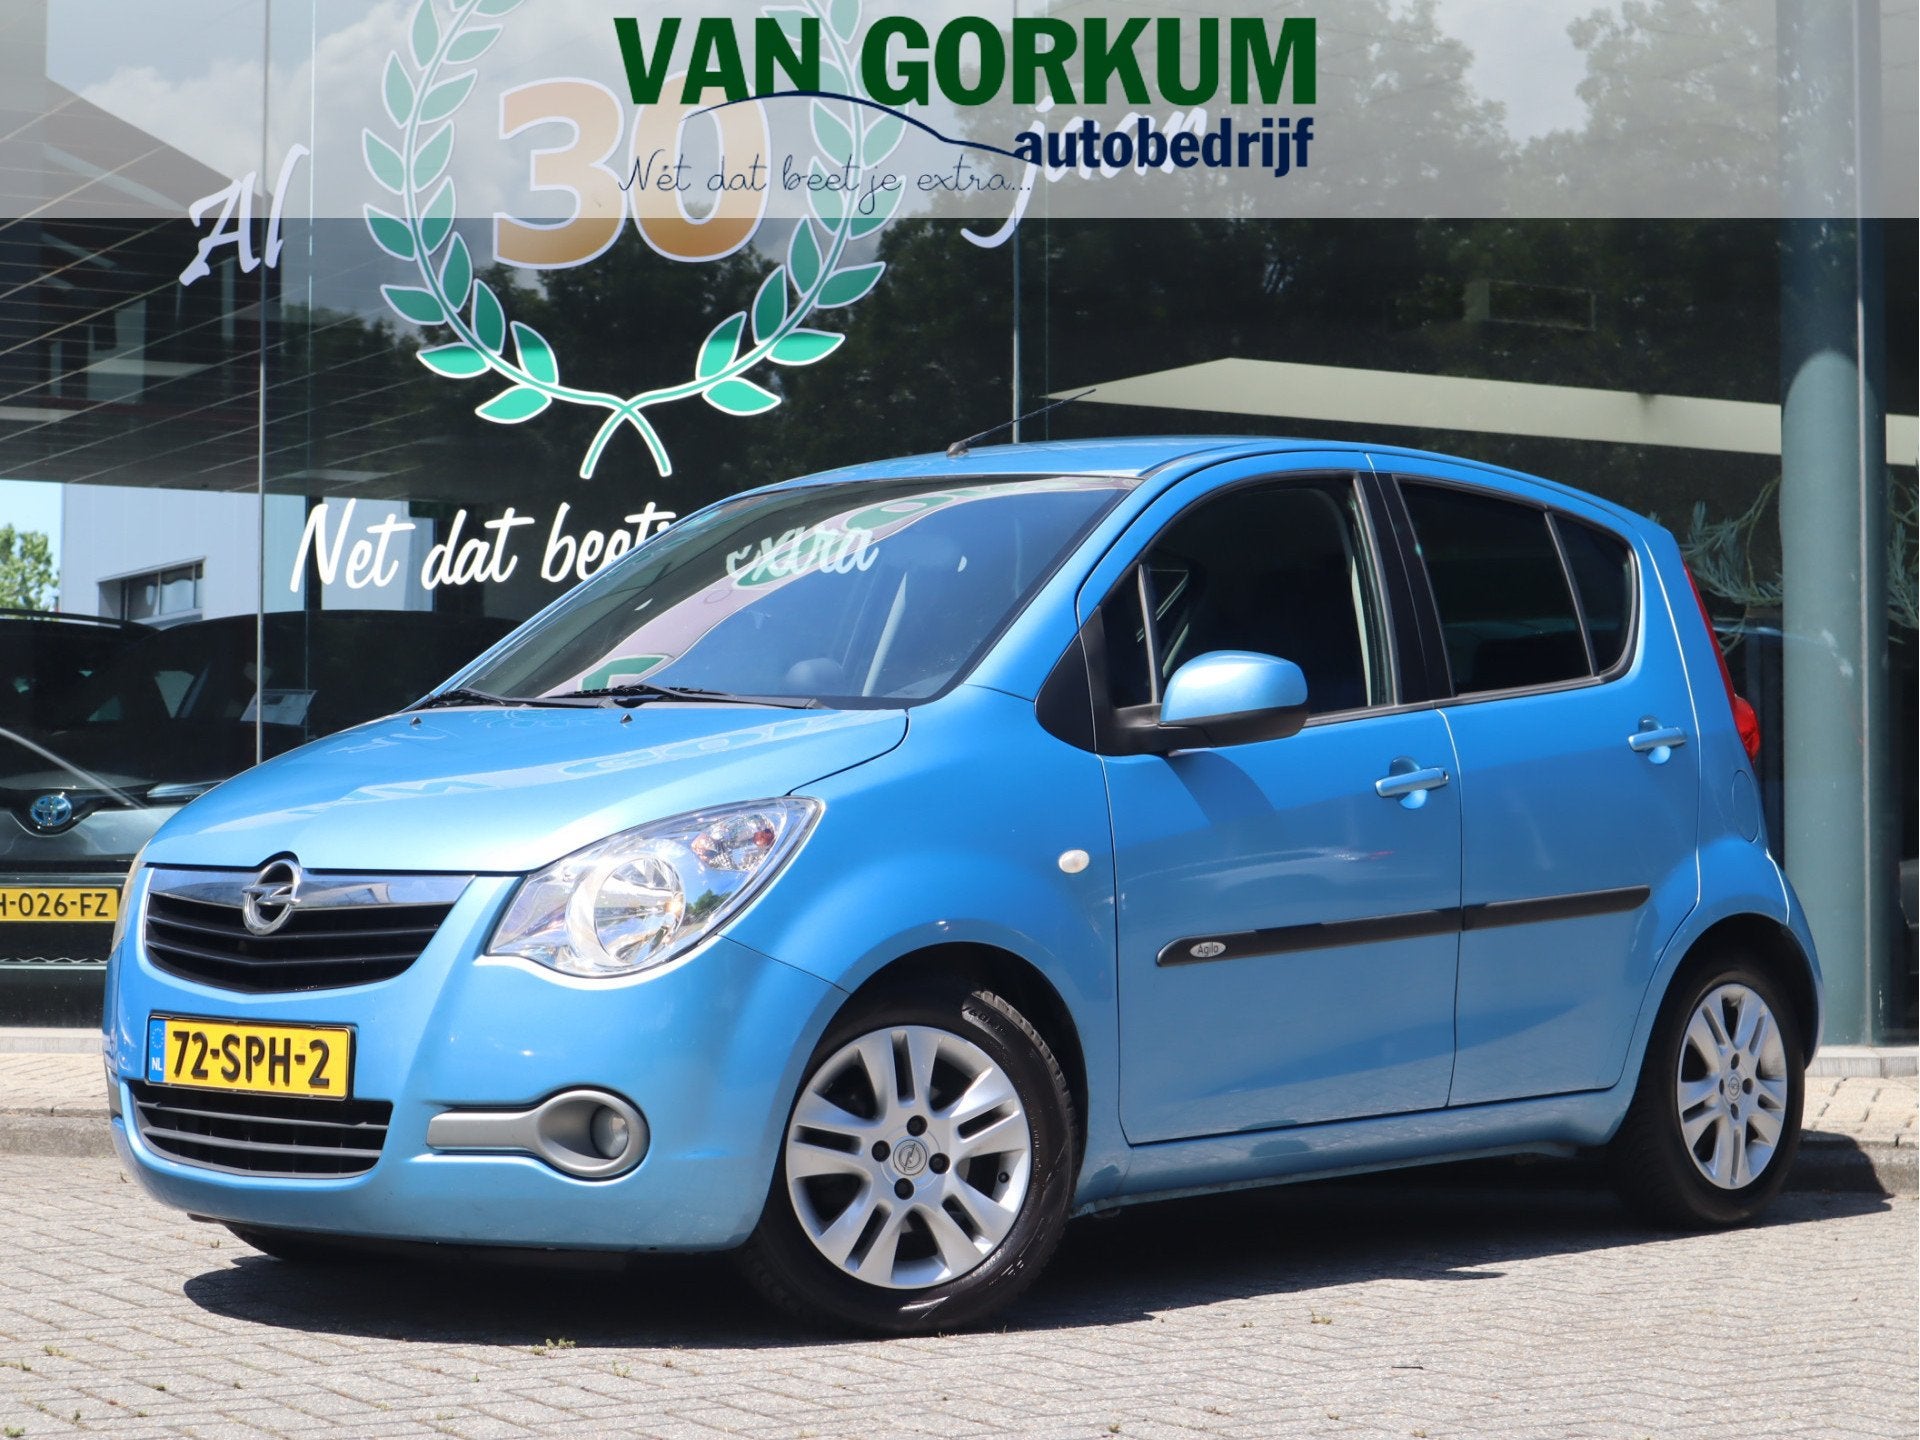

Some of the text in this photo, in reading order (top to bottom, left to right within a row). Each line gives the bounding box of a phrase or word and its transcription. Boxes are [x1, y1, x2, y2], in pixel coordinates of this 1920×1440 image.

[179, 143, 310, 287] Al
[492, 68, 772, 270] 30
[289, 498, 417, 593] Net
[420, 507, 536, 591] dat
[540, 501, 677, 582] beet
[151, 1057, 163, 1072] NL
[173, 1030, 330, 1090] 72-SPH-2
